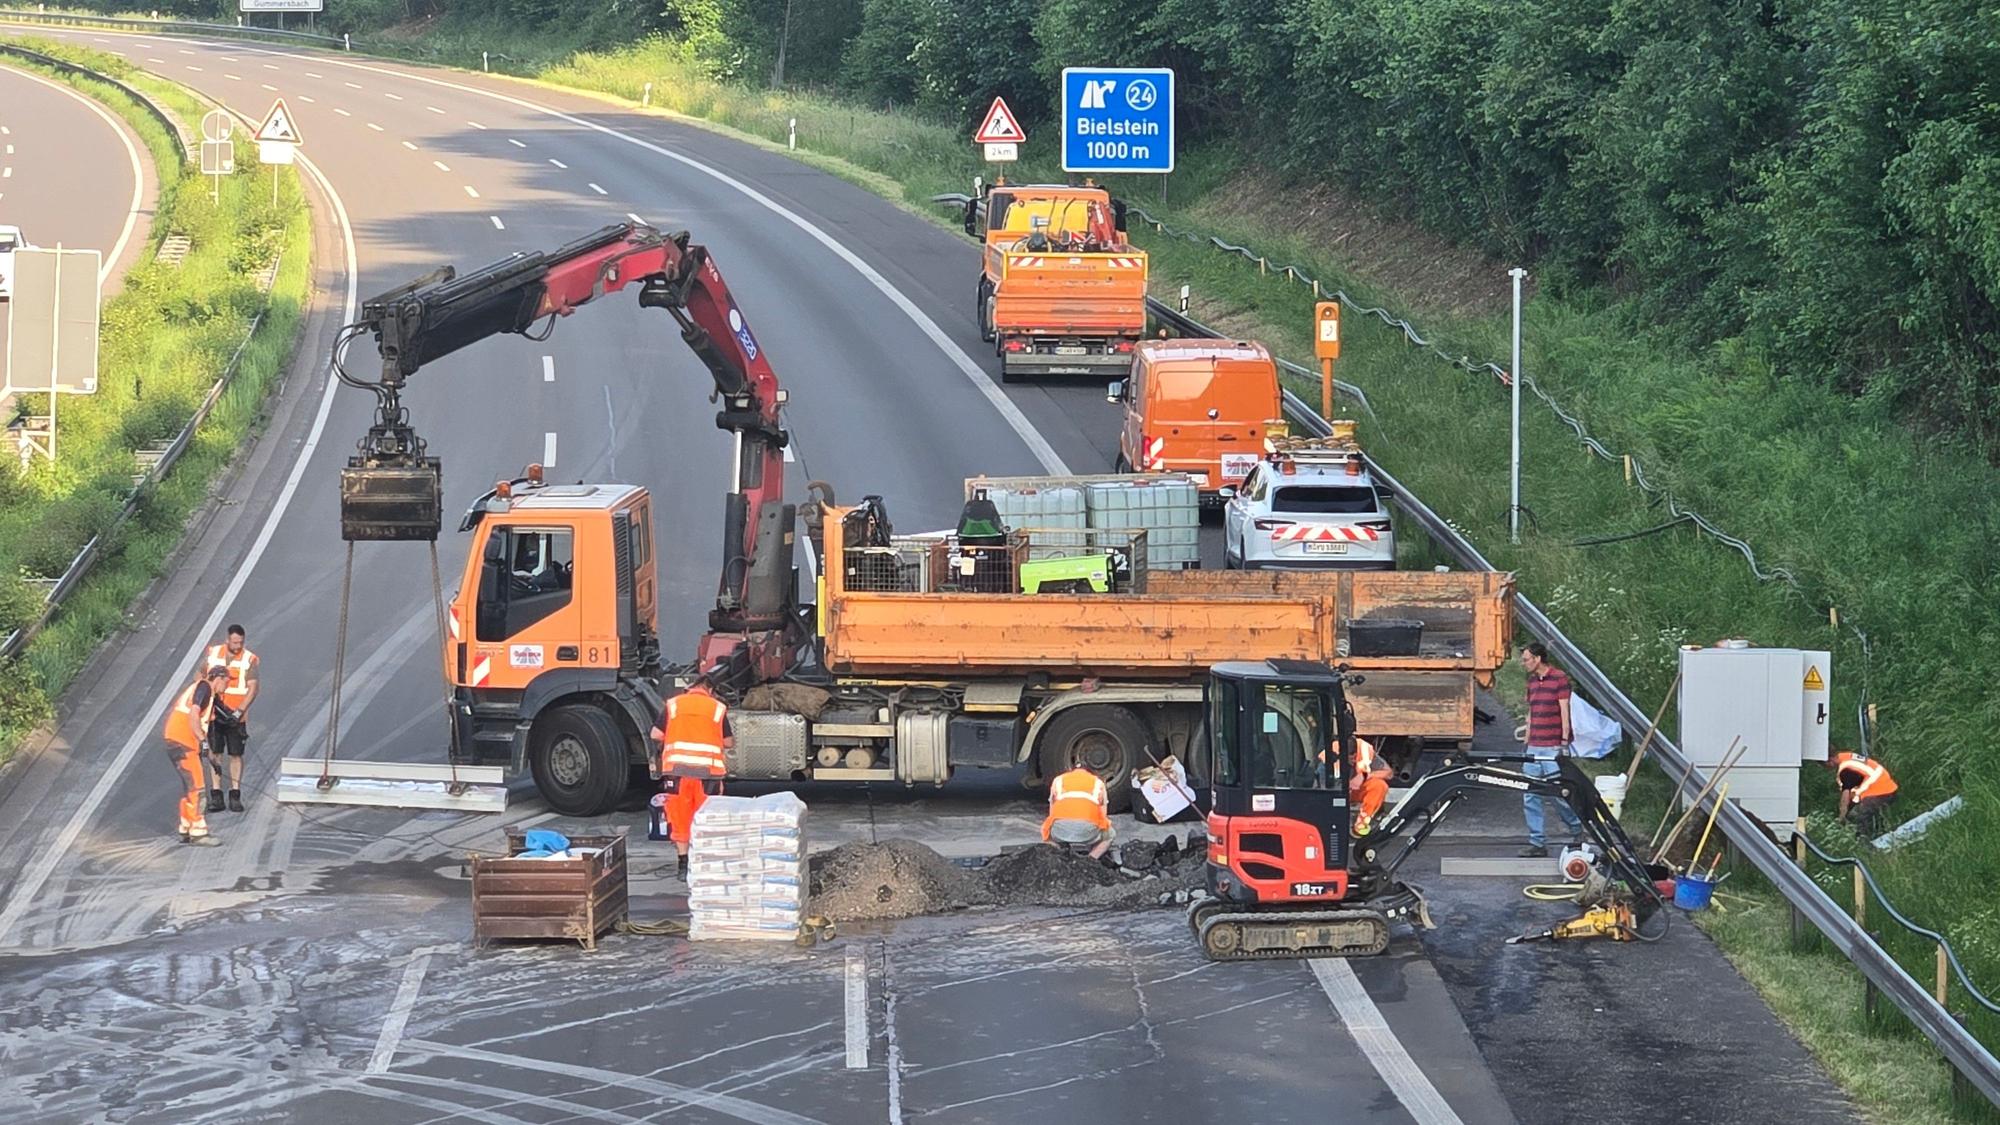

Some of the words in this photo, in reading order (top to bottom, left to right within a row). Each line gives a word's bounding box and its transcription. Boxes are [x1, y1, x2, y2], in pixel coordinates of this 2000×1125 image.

[1130, 86, 1152, 103] 24
[1077, 117, 1159, 135] Bielstein
[998, 147, 1012, 156] km
[1086, 141, 1128, 159] 1000
[1131, 146, 1149, 159] m
[589, 646, 609, 664] 81
